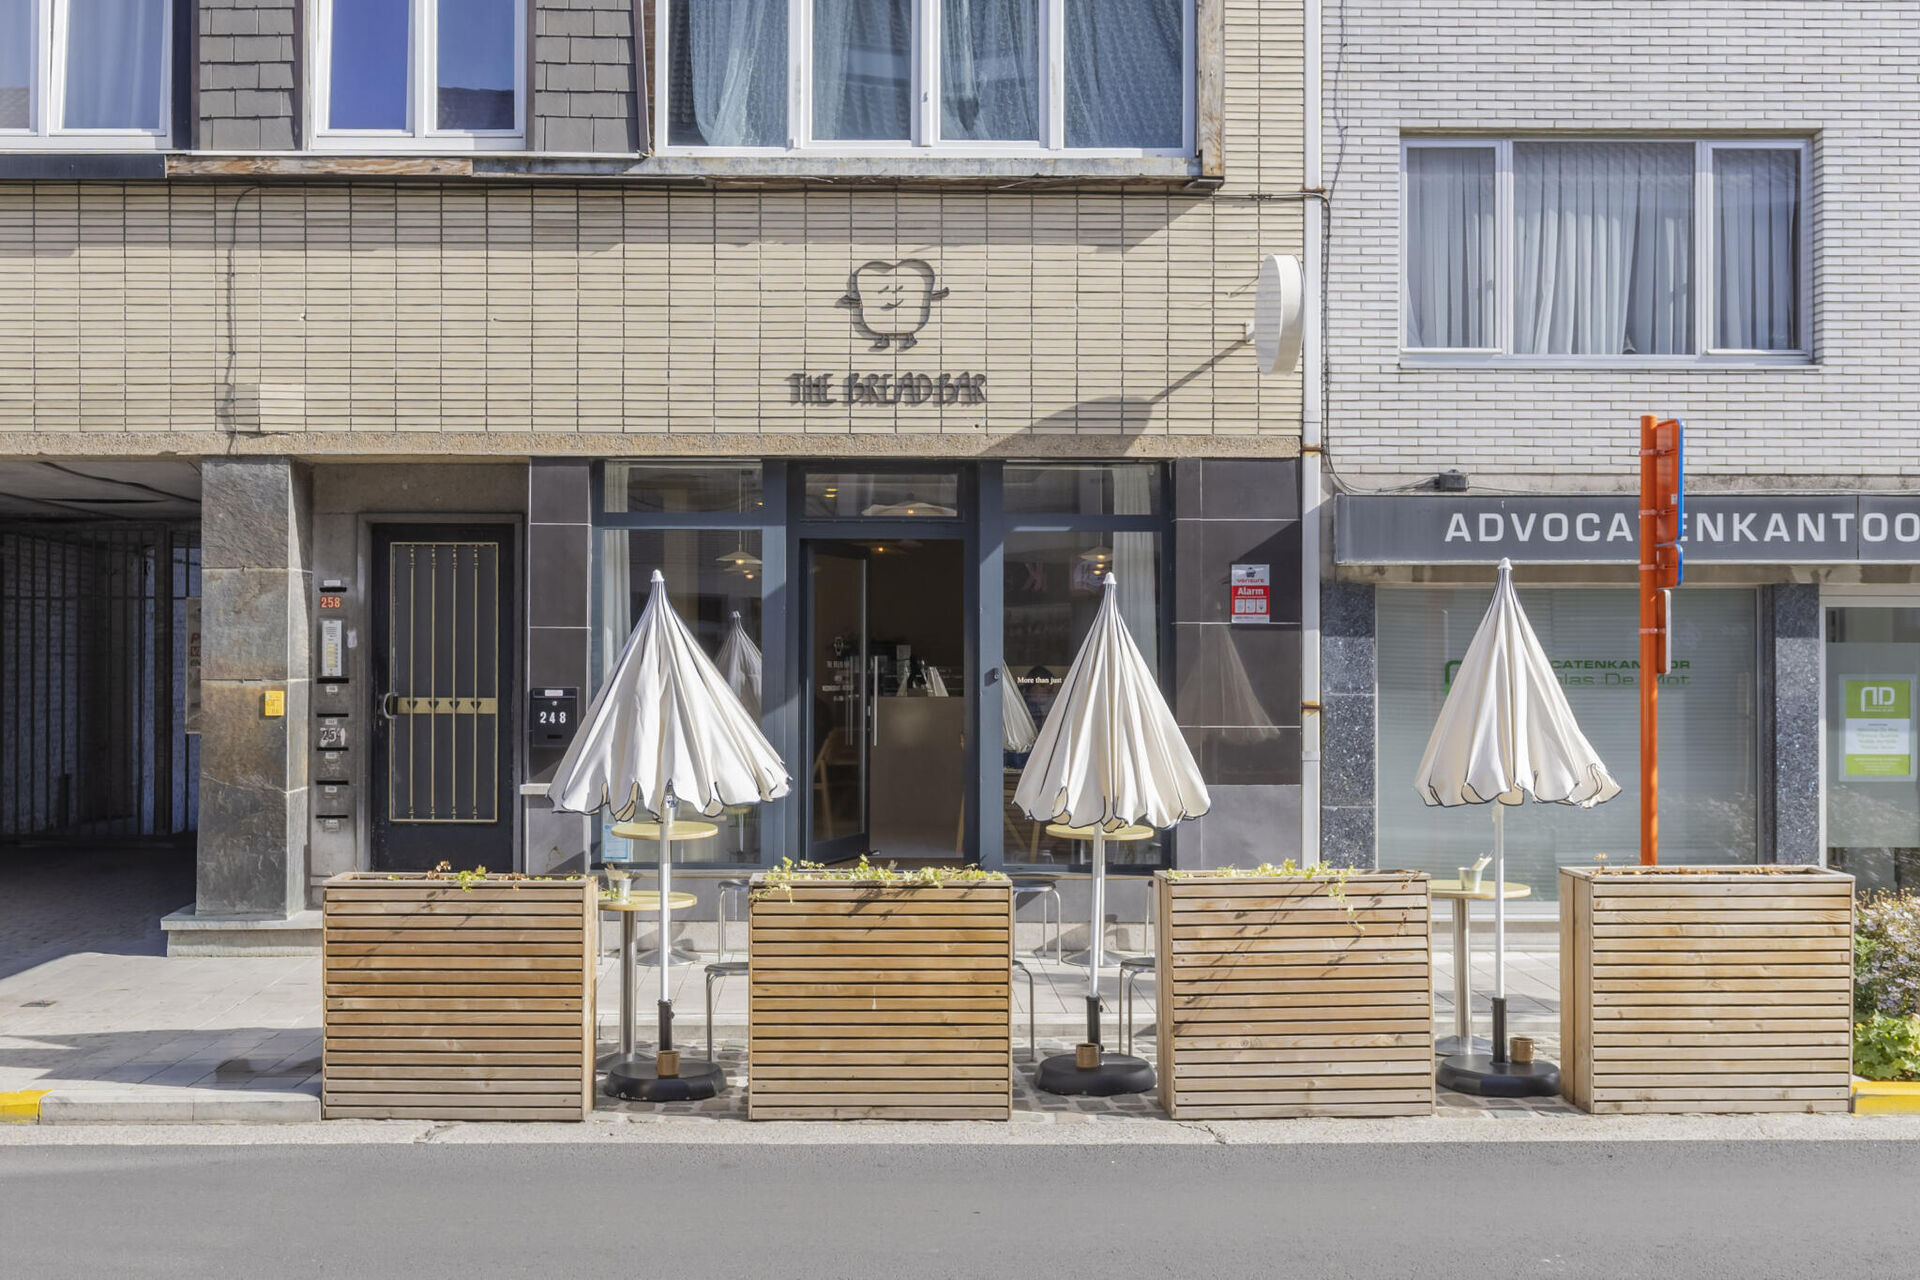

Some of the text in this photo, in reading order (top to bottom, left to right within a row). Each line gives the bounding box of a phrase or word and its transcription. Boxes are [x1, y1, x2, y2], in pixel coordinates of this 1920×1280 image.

[786, 373, 837, 405] THE
[1445, 512, 1920, 543] ADVOCANKANTOO
[1237, 586, 1264, 596] Alarm
[321, 596, 341, 608] 258
[1017, 676, 1062, 685] More than just
[539, 711, 566, 724] 248
